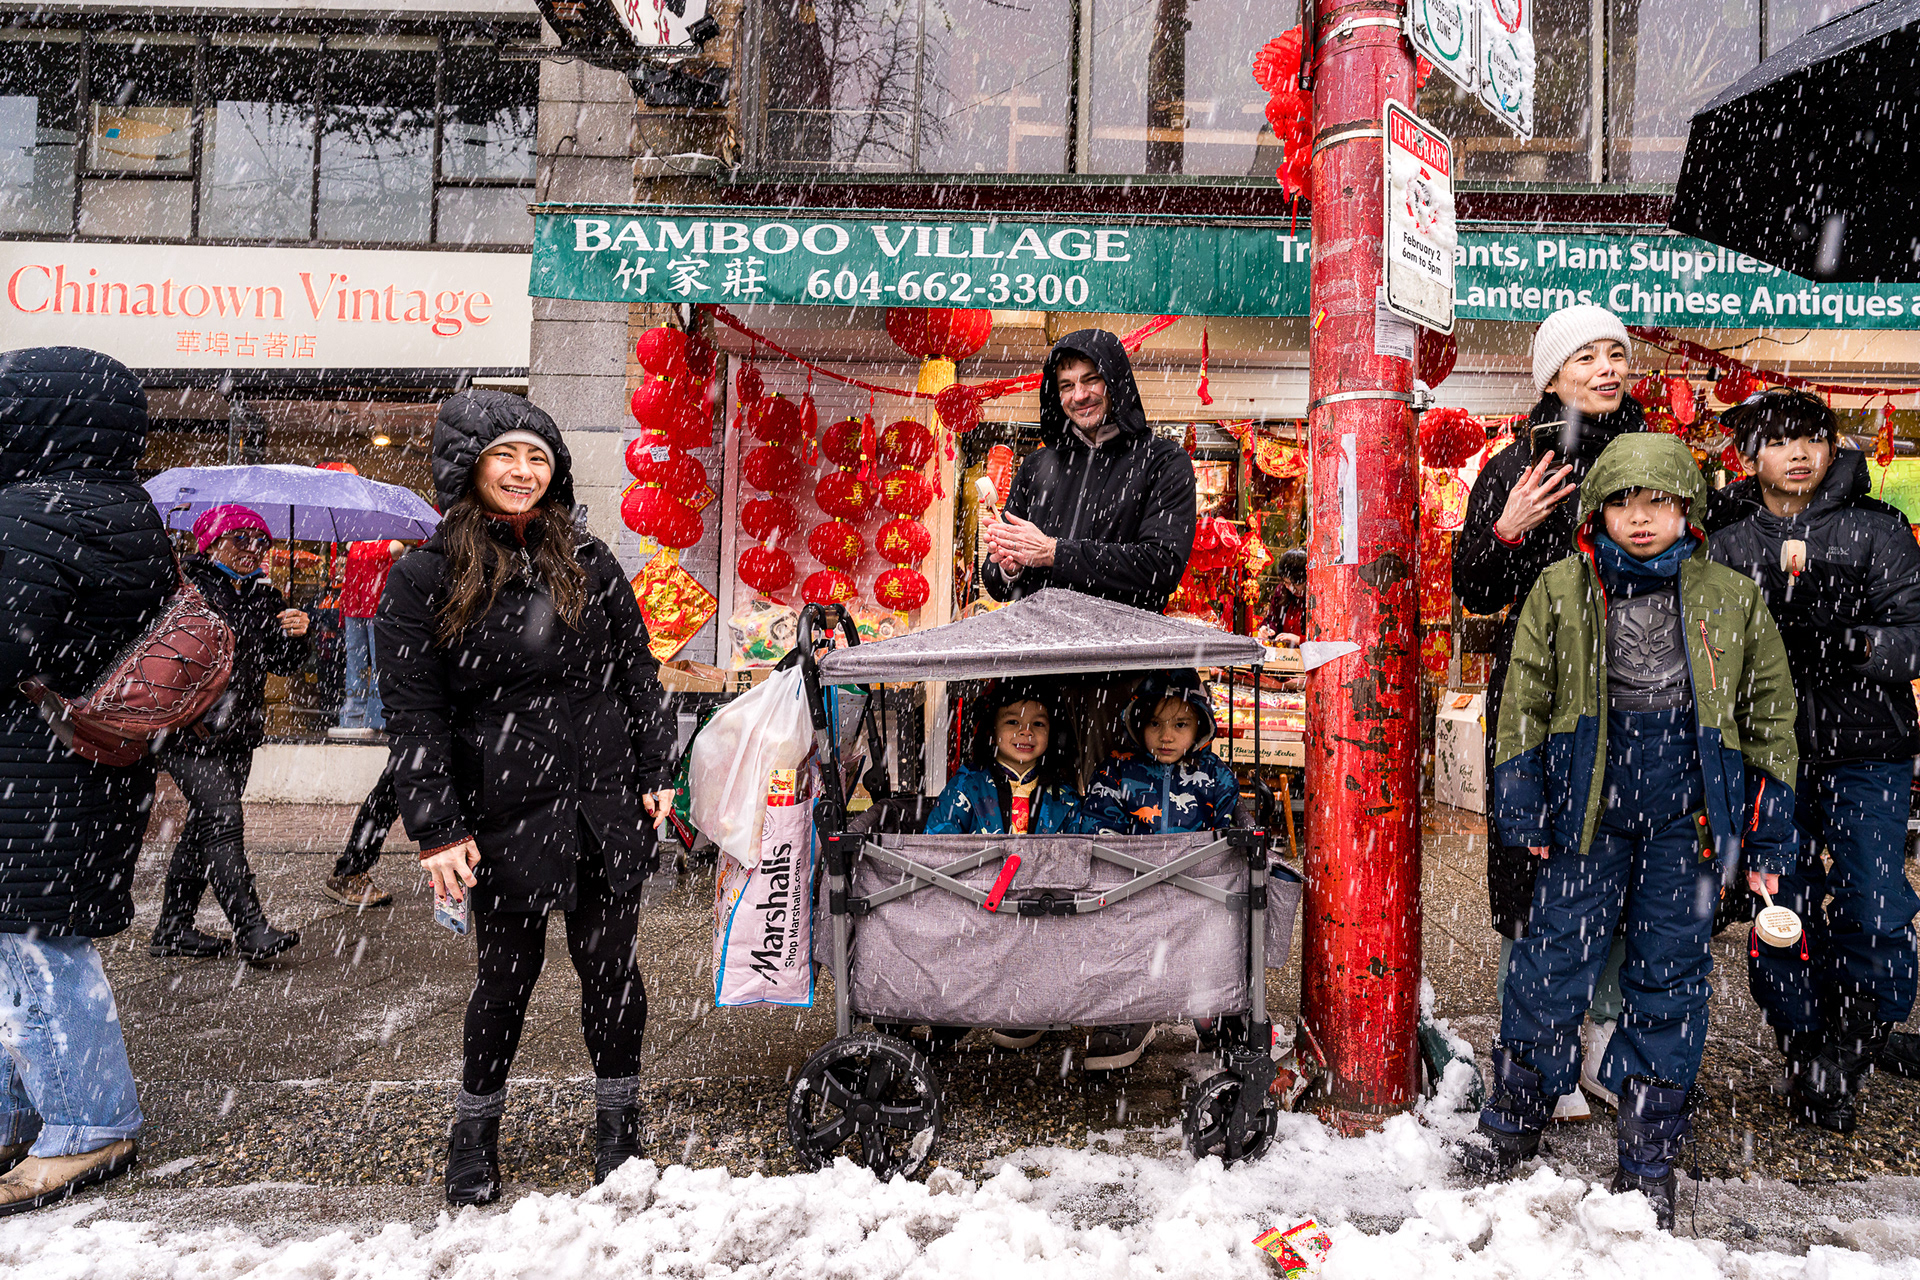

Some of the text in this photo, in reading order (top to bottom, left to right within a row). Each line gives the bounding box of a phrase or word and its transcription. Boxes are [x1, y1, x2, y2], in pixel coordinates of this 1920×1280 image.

[1436, 17, 1452, 41] ZONE
[573, 219, 1131, 262] BAMBOO VILLAGE
[1403, 231, 1442, 261] February 2
[1537, 240, 1623, 271] Plant
[1630, 243, 1783, 280] Supplies,
[612, 254, 767, 297] 竹家莊
[1402, 247, 1442, 276] 6am to 5pm
[7, 264, 494, 338] Chinatown Vintage
[807, 269, 1090, 305] 604-662-3300
[1609, 283, 1742, 315] Chinese
[1749, 286, 1905, 323] Antiques
[176, 330, 318, 360] 華埠古著店
[1234, 746, 1272, 757] Burnby
[1274, 749, 1297, 757] Lake
[750, 843, 791, 986] Marshalls
[785, 857, 802, 968] Shop Marshalls.com
